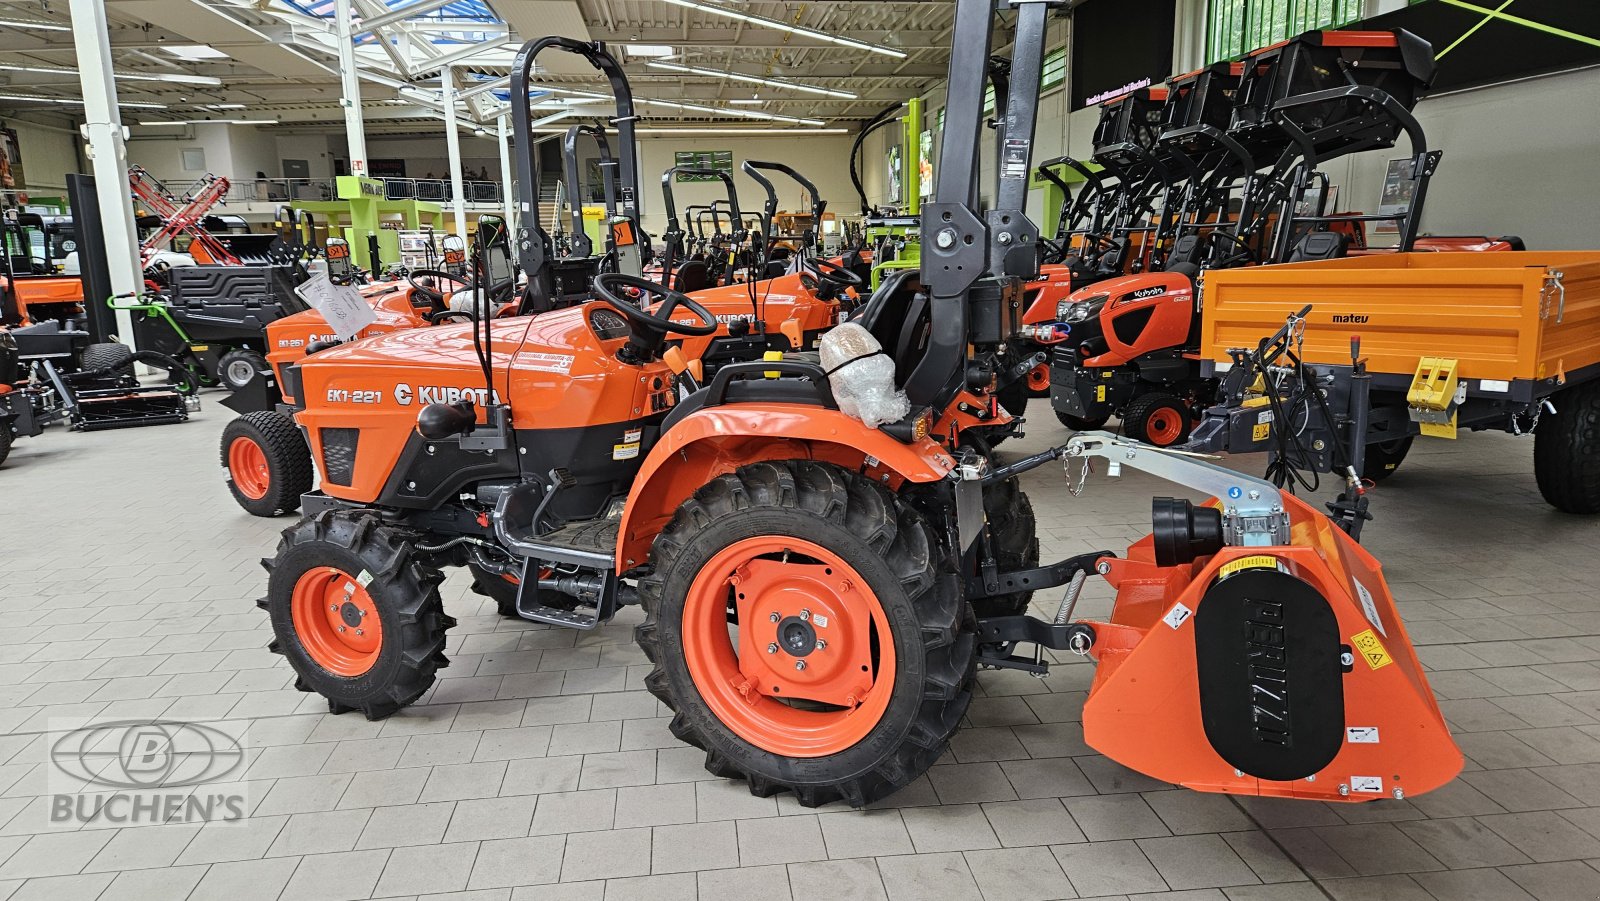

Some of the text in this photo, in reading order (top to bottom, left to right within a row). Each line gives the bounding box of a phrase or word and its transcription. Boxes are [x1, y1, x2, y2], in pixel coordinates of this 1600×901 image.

[1134, 287, 1163, 298] Kubota
[1332, 314, 1369, 324] matev
[327, 389, 382, 404] EK1-221
[418, 386, 502, 407] KUBOTA
